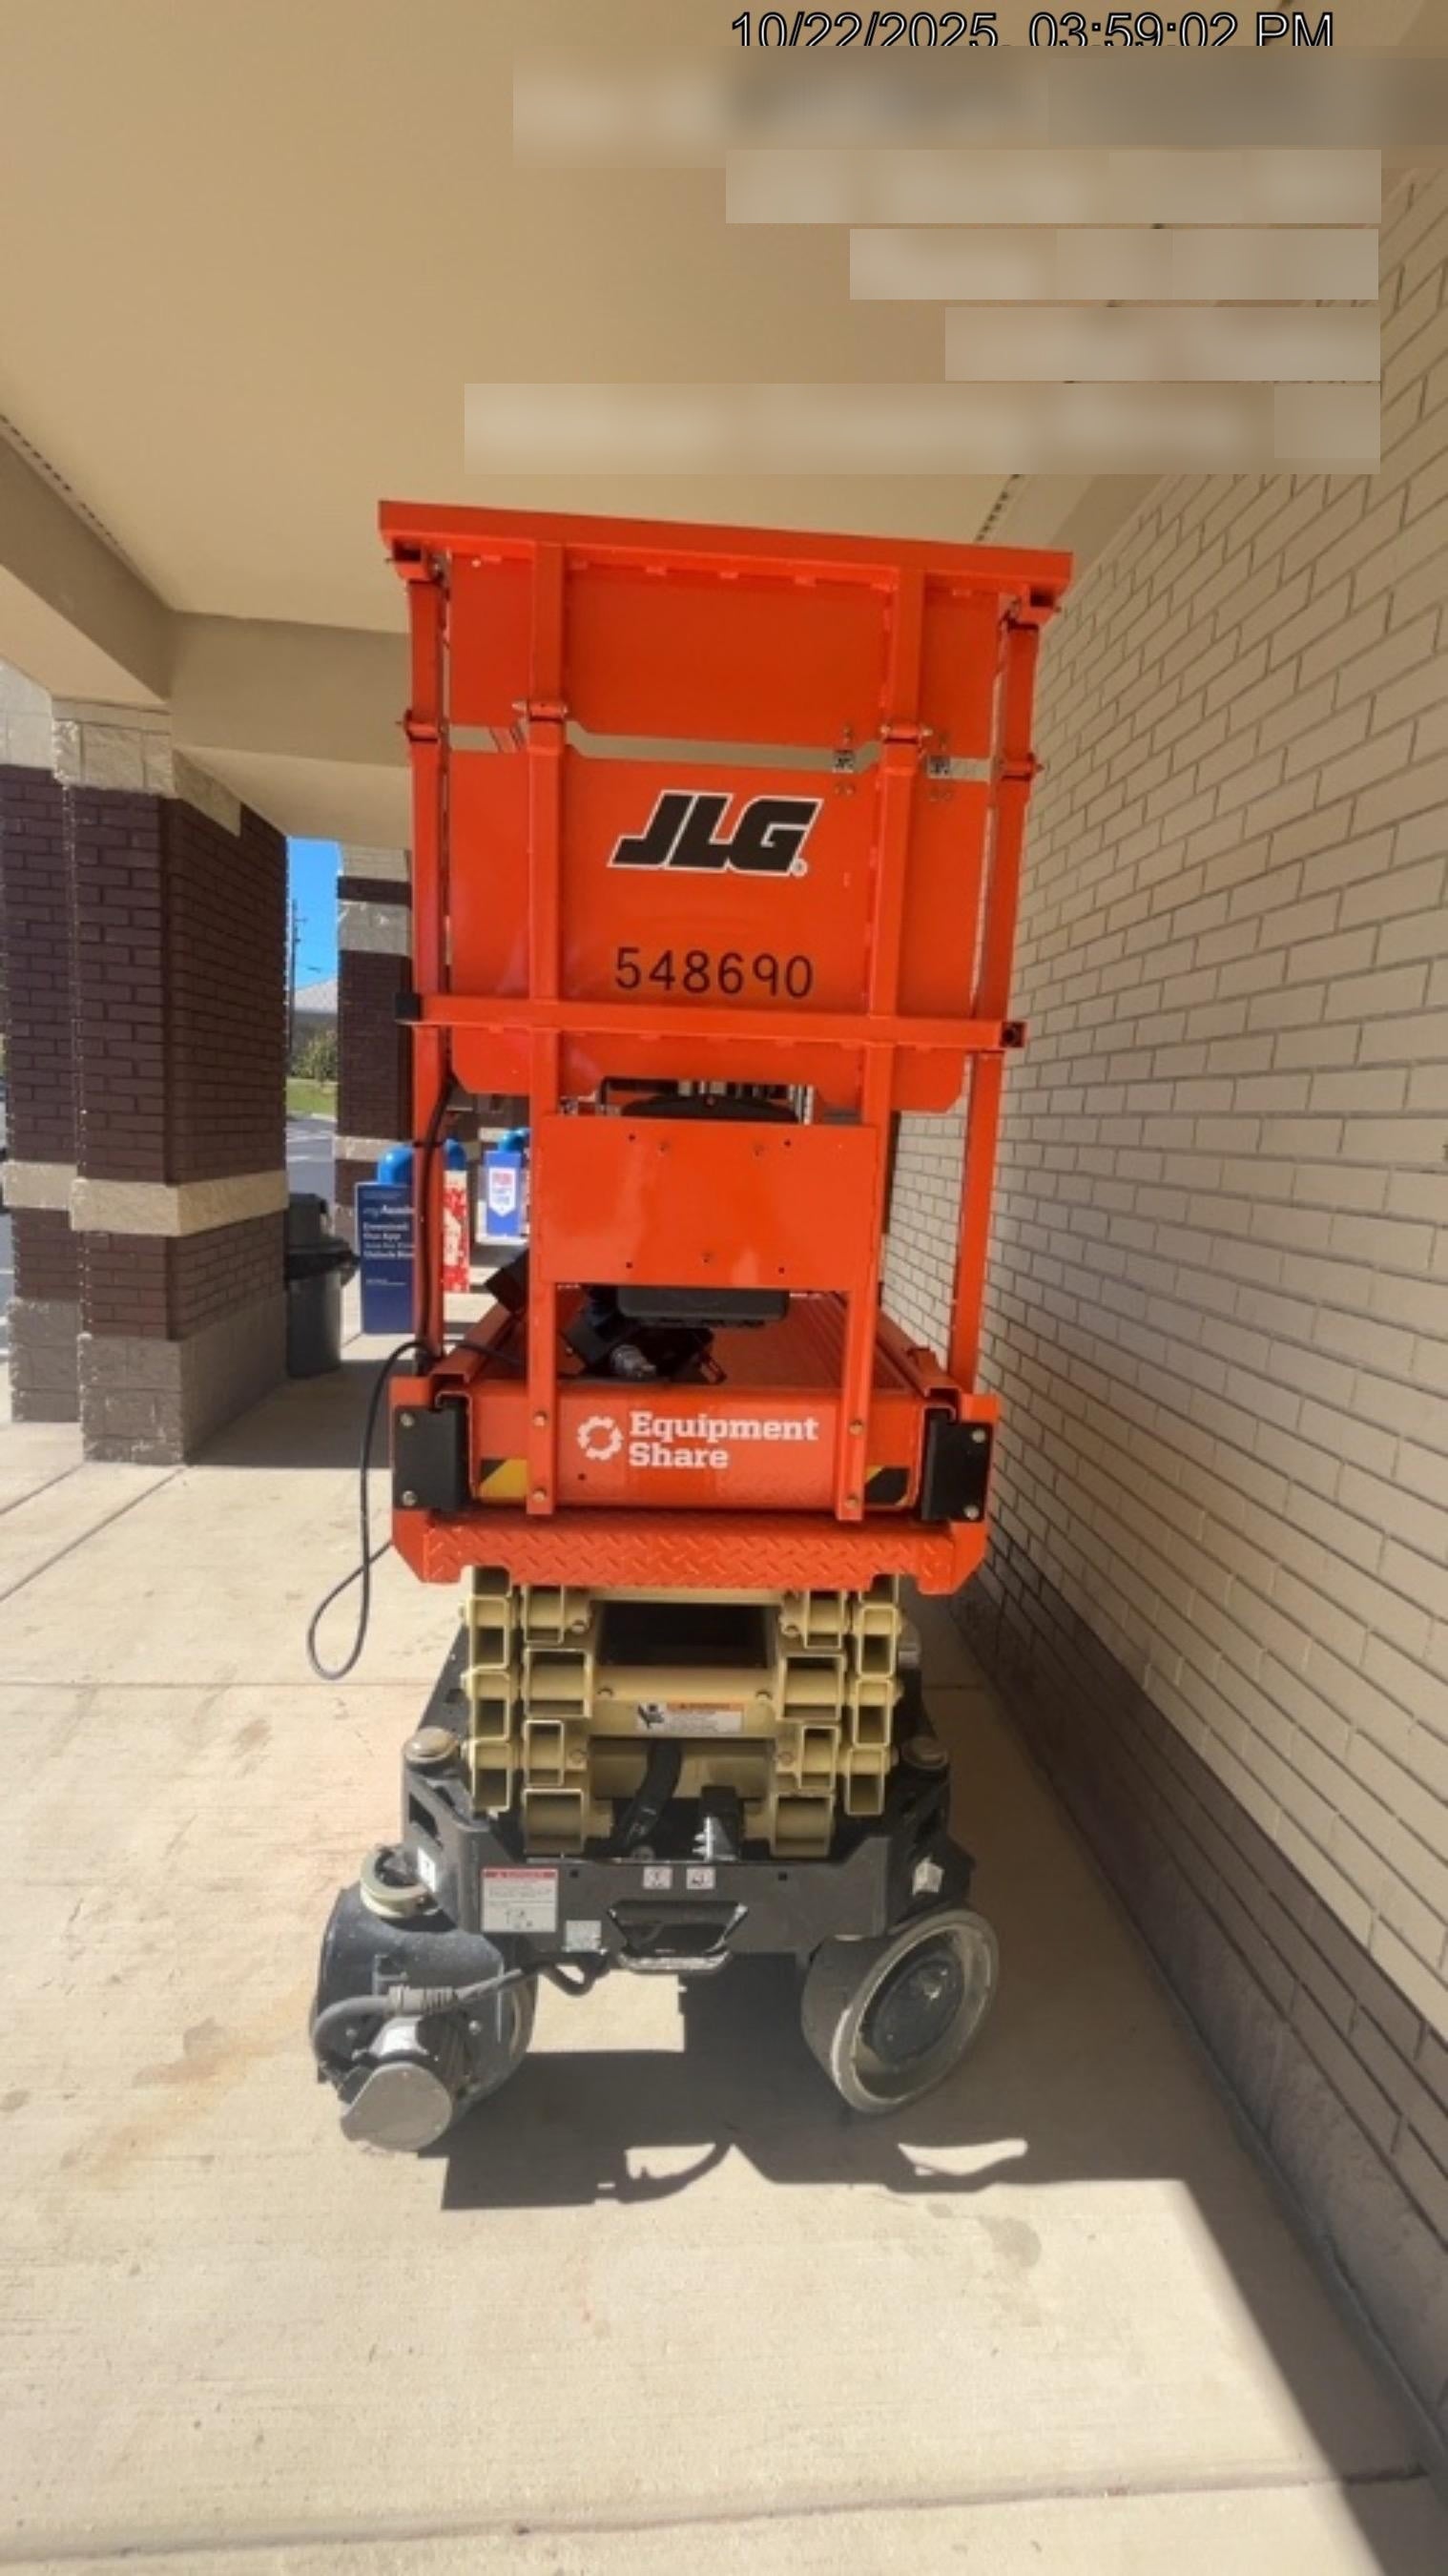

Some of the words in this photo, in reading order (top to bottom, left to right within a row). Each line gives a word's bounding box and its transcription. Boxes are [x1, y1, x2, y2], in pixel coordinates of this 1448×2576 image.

[609, 791, 823, 876] JLG
[615, 946, 813, 999] 548690
[629, 1411, 819, 1443] Equipment
[629, 1442, 729, 1468] Share
